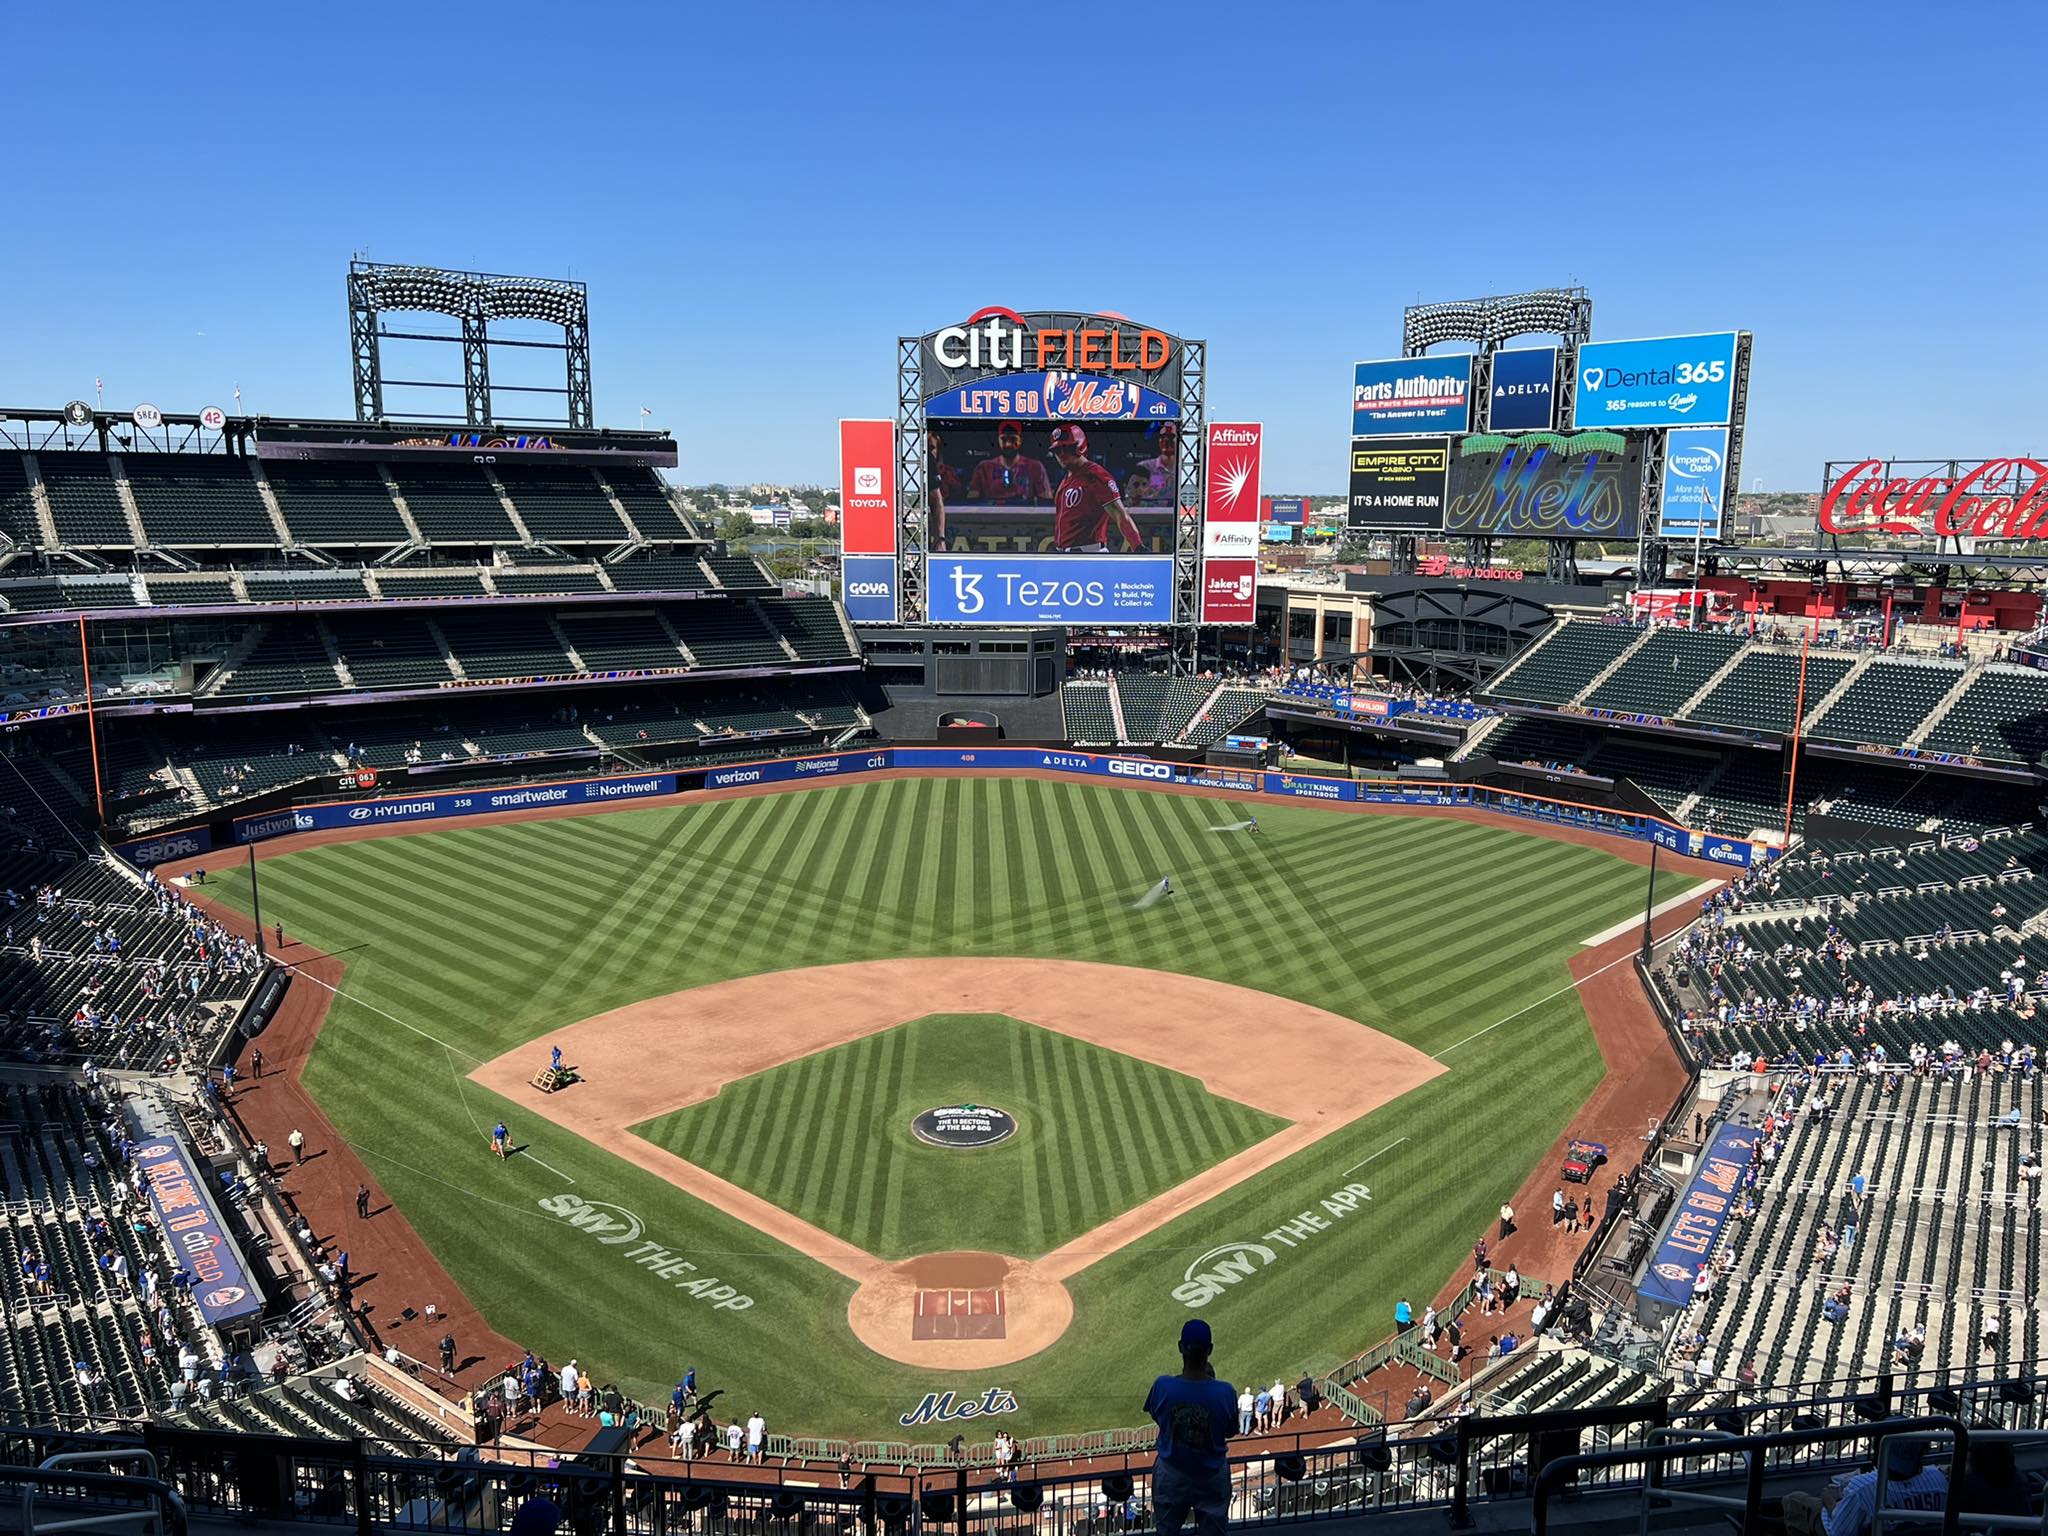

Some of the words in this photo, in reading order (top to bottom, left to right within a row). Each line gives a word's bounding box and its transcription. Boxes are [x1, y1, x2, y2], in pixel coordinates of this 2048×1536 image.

[934, 317, 1022, 369] citi
[1036, 328, 1170, 370] FIELD
[1604, 360, 1726, 388] Dental365
[1355, 381, 1393, 402] Parts
[1393, 374, 1465, 399] Authority
[1507, 383, 1550, 395] DELTA
[960, 389, 1010, 413] LET'S
[1015, 390, 1039, 413] GO
[1057, 381, 1123, 415] Mets
[1605, 399, 1627, 411] 365
[1627, 400, 1657, 408] reasons
[1667, 393, 1699, 411] Smile
[136, 410, 158, 420] SHEA
[1149, 401, 1167, 415] citi
[1387, 410, 1416, 418] Answer
[204, 411, 222, 425] 42
[1212, 429, 1259, 446] Affinity
[1357, 456, 1407, 466] EMPIRE
[1675, 455, 1711, 466] Imperial
[1689, 463, 1713, 473] Dade
[1445, 442, 1623, 530] Mets
[1675, 485, 1690, 493] More
[849, 499, 888, 508] TOYOTA
[1353, 495, 1373, 507] IT'S
[1373, 496, 1382, 506] A
[1383, 495, 1414, 507] HOME
[1416, 496, 1439, 507] RUN
[1220, 534, 1252, 545] Affinity
[1450, 567, 1473, 577] new
[1474, 566, 1524, 581] balance
[849, 582, 890, 596] GOYA
[996, 573, 1104, 607] Tezos
[1120, 582, 1154, 590] Blockchain
[1208, 577, 1239, 589] Jake's
[1336, 699, 1348, 707] citi
[1352, 700, 1385, 712] PAVILION
[804, 758, 839, 770] National
[867, 756, 885, 767] citi
[1053, 756, 1088, 768] DELTA
[358, 772, 375, 782] 063
[715, 769, 760, 784] verizon
[1108, 760, 1171, 779] GEICO
[338, 776, 356, 786] citi
[600, 780, 658, 796] Northwell
[1199, 779, 1225, 788] KONICA
[1224, 782, 1254, 791] MINOLTA
[1282, 781, 1340, 792] DRAFTKINGS
[490, 789, 568, 806] smartwater
[1295, 789, 1339, 799] SPORTSBOOK
[1436, 796, 1452, 805] 370
[375, 802, 435, 817] HYUNDAI
[454, 799, 472, 808] 358
[241, 814, 314, 840] Justworks
[1708, 846, 1743, 862] Corona
[1700, 1157, 1743, 1194] Mets!
[144, 1159, 200, 1214] WELCOME
[1687, 1191, 1728, 1213] GO
[167, 1208, 210, 1232] TO
[1666, 1211, 1718, 1255] LET'S
[181, 1231, 216, 1253] citi
[1170, 1250, 1258, 1308] SNY
[1262, 1210, 1333, 1247] THE
[1319, 1182, 1373, 1218] APP
[537, 1193, 628, 1234] SNY
[623, 1240, 698, 1280] THE
[674, 1277, 755, 1311] APP
[190, 1247, 225, 1283] FIELD
[899, 1386, 1019, 1426] Mets
